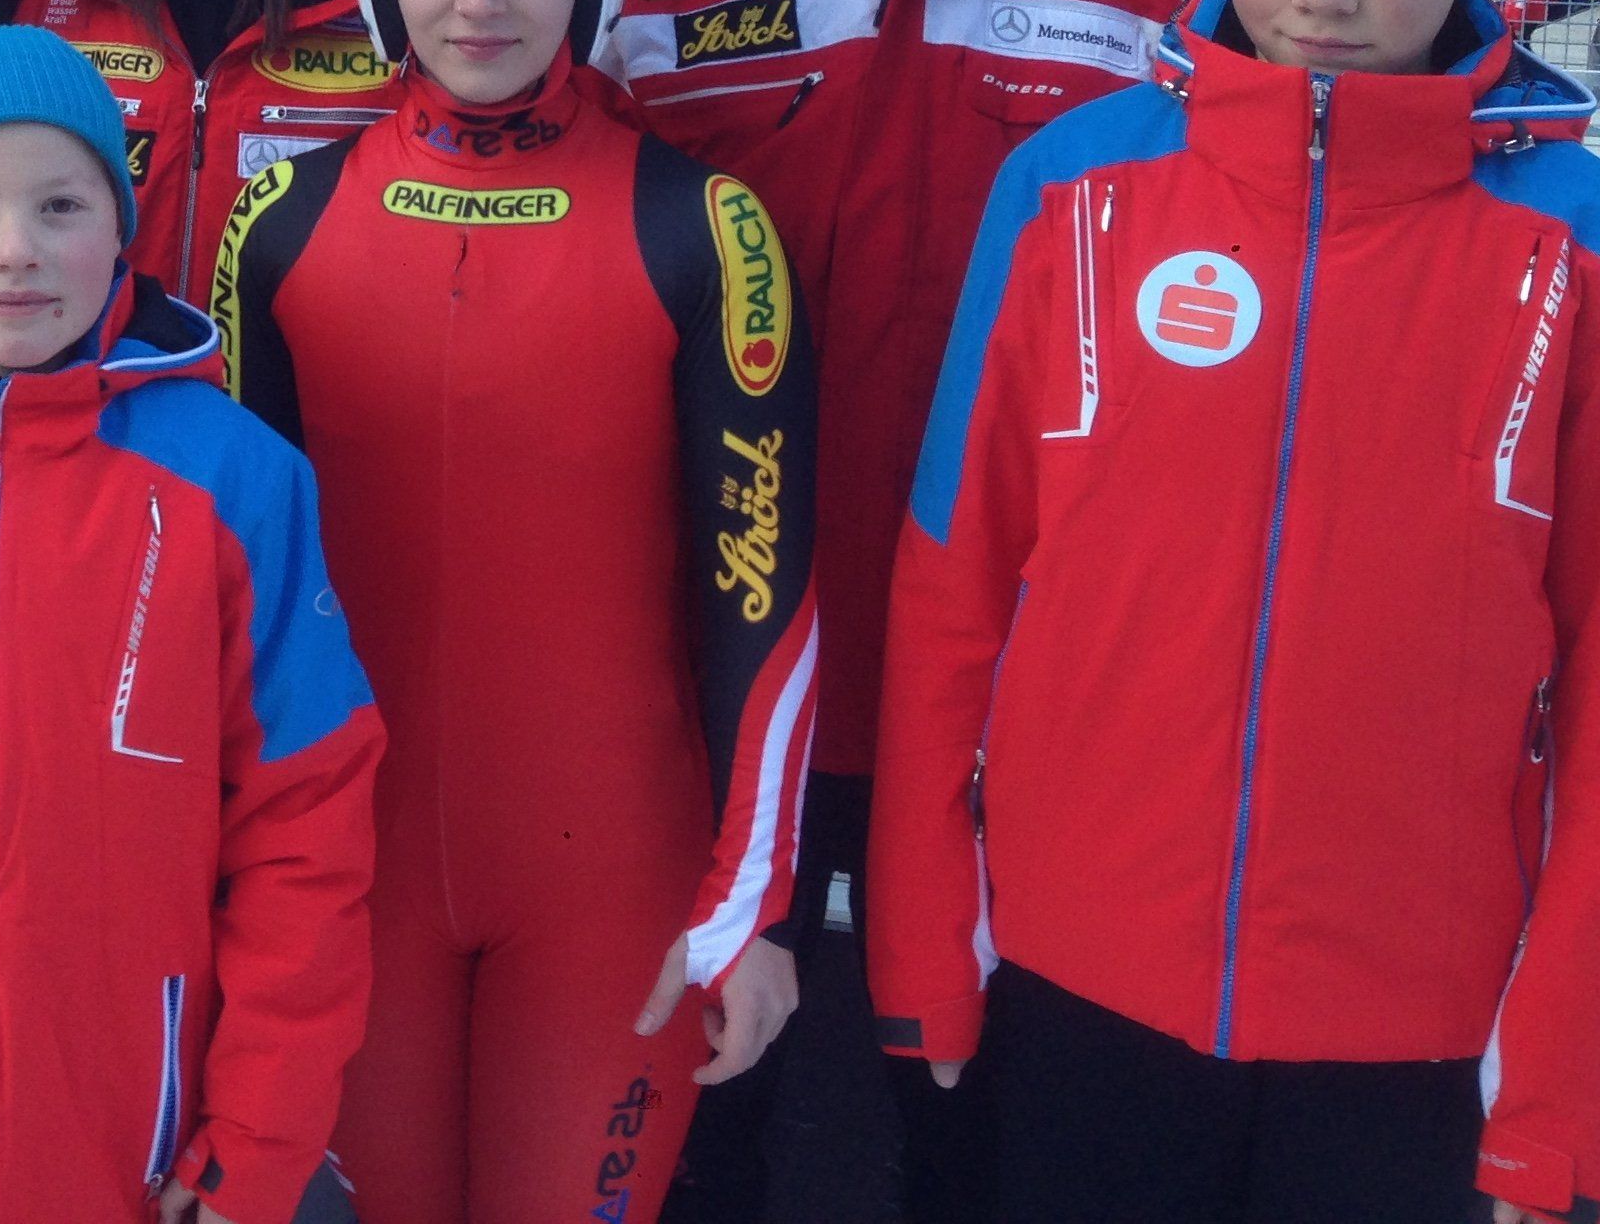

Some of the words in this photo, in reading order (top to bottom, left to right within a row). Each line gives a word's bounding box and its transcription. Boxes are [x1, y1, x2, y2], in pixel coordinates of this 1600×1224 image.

[1037, 24, 1133, 55] Mercedes-Benz
[391, 185, 557, 219] PALFINGER
[721, 191, 775, 335] RAUCH
[1522, 314, 1553, 387] WEST
[127, 596, 148, 654] WEST
[139, 531, 161, 599] SCOUT
